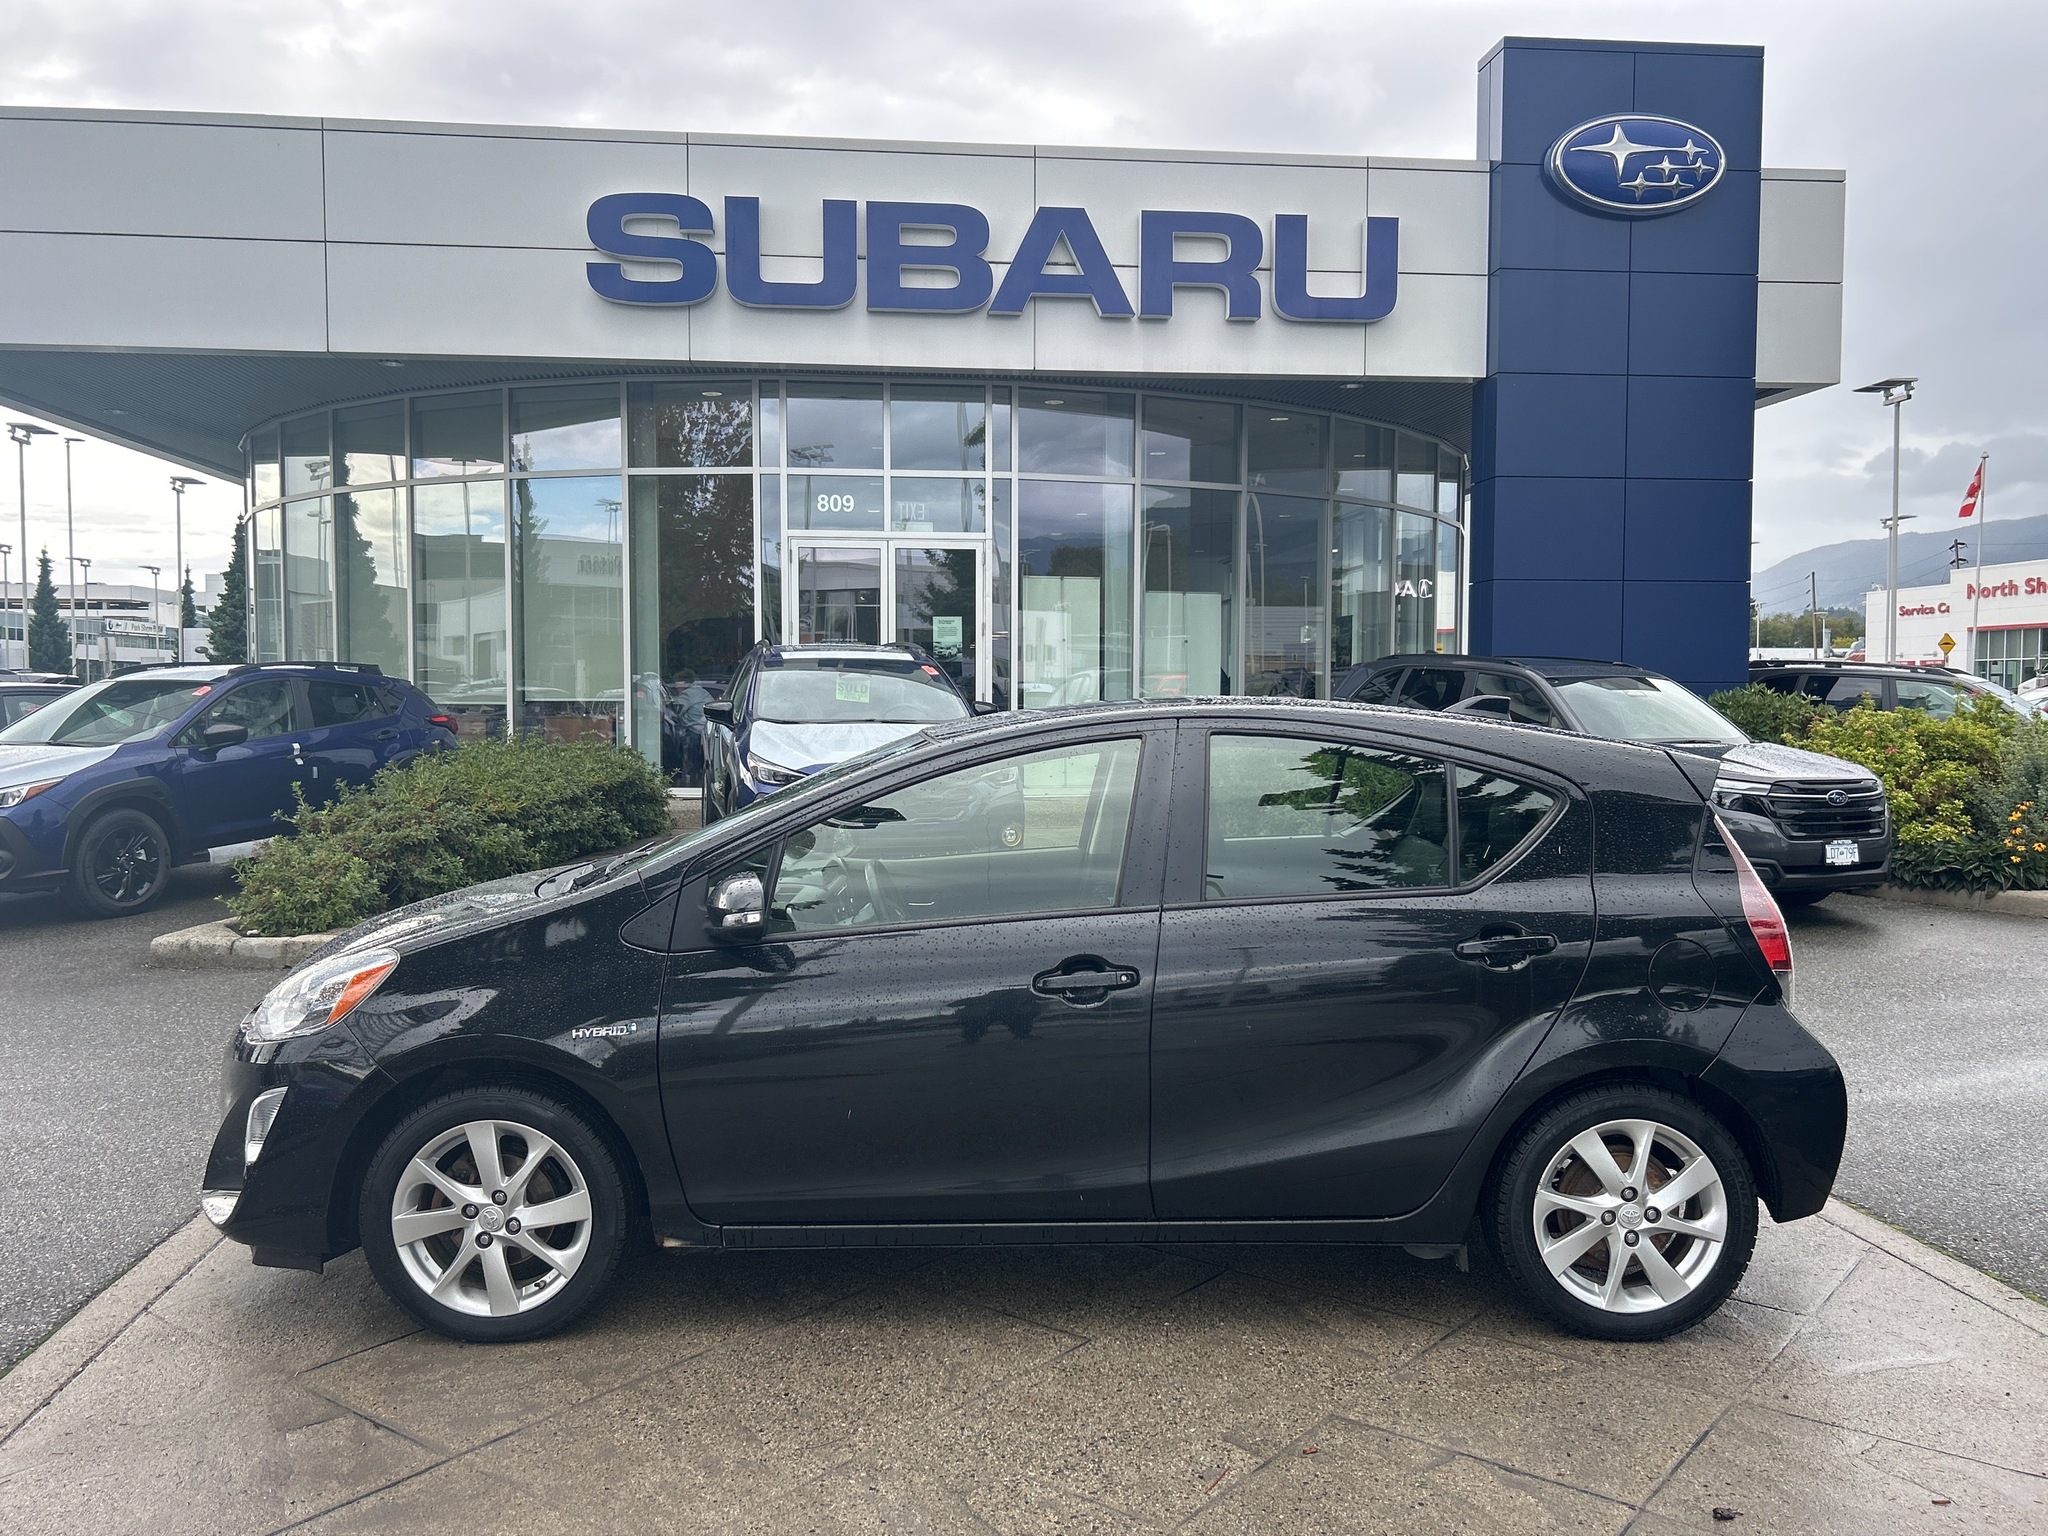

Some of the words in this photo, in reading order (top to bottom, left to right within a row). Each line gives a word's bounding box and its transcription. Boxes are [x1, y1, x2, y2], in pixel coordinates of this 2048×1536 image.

[585, 192, 1400, 323] SUBARU
[817, 494, 855, 512] 809
[1966, 579, 2019, 600] North
[2024, 576, 2048, 595] Sh
[1898, 604, 1936, 617] Service
[837, 681, 869, 694] SOLD
[572, 1025, 627, 1039] HYBRID
